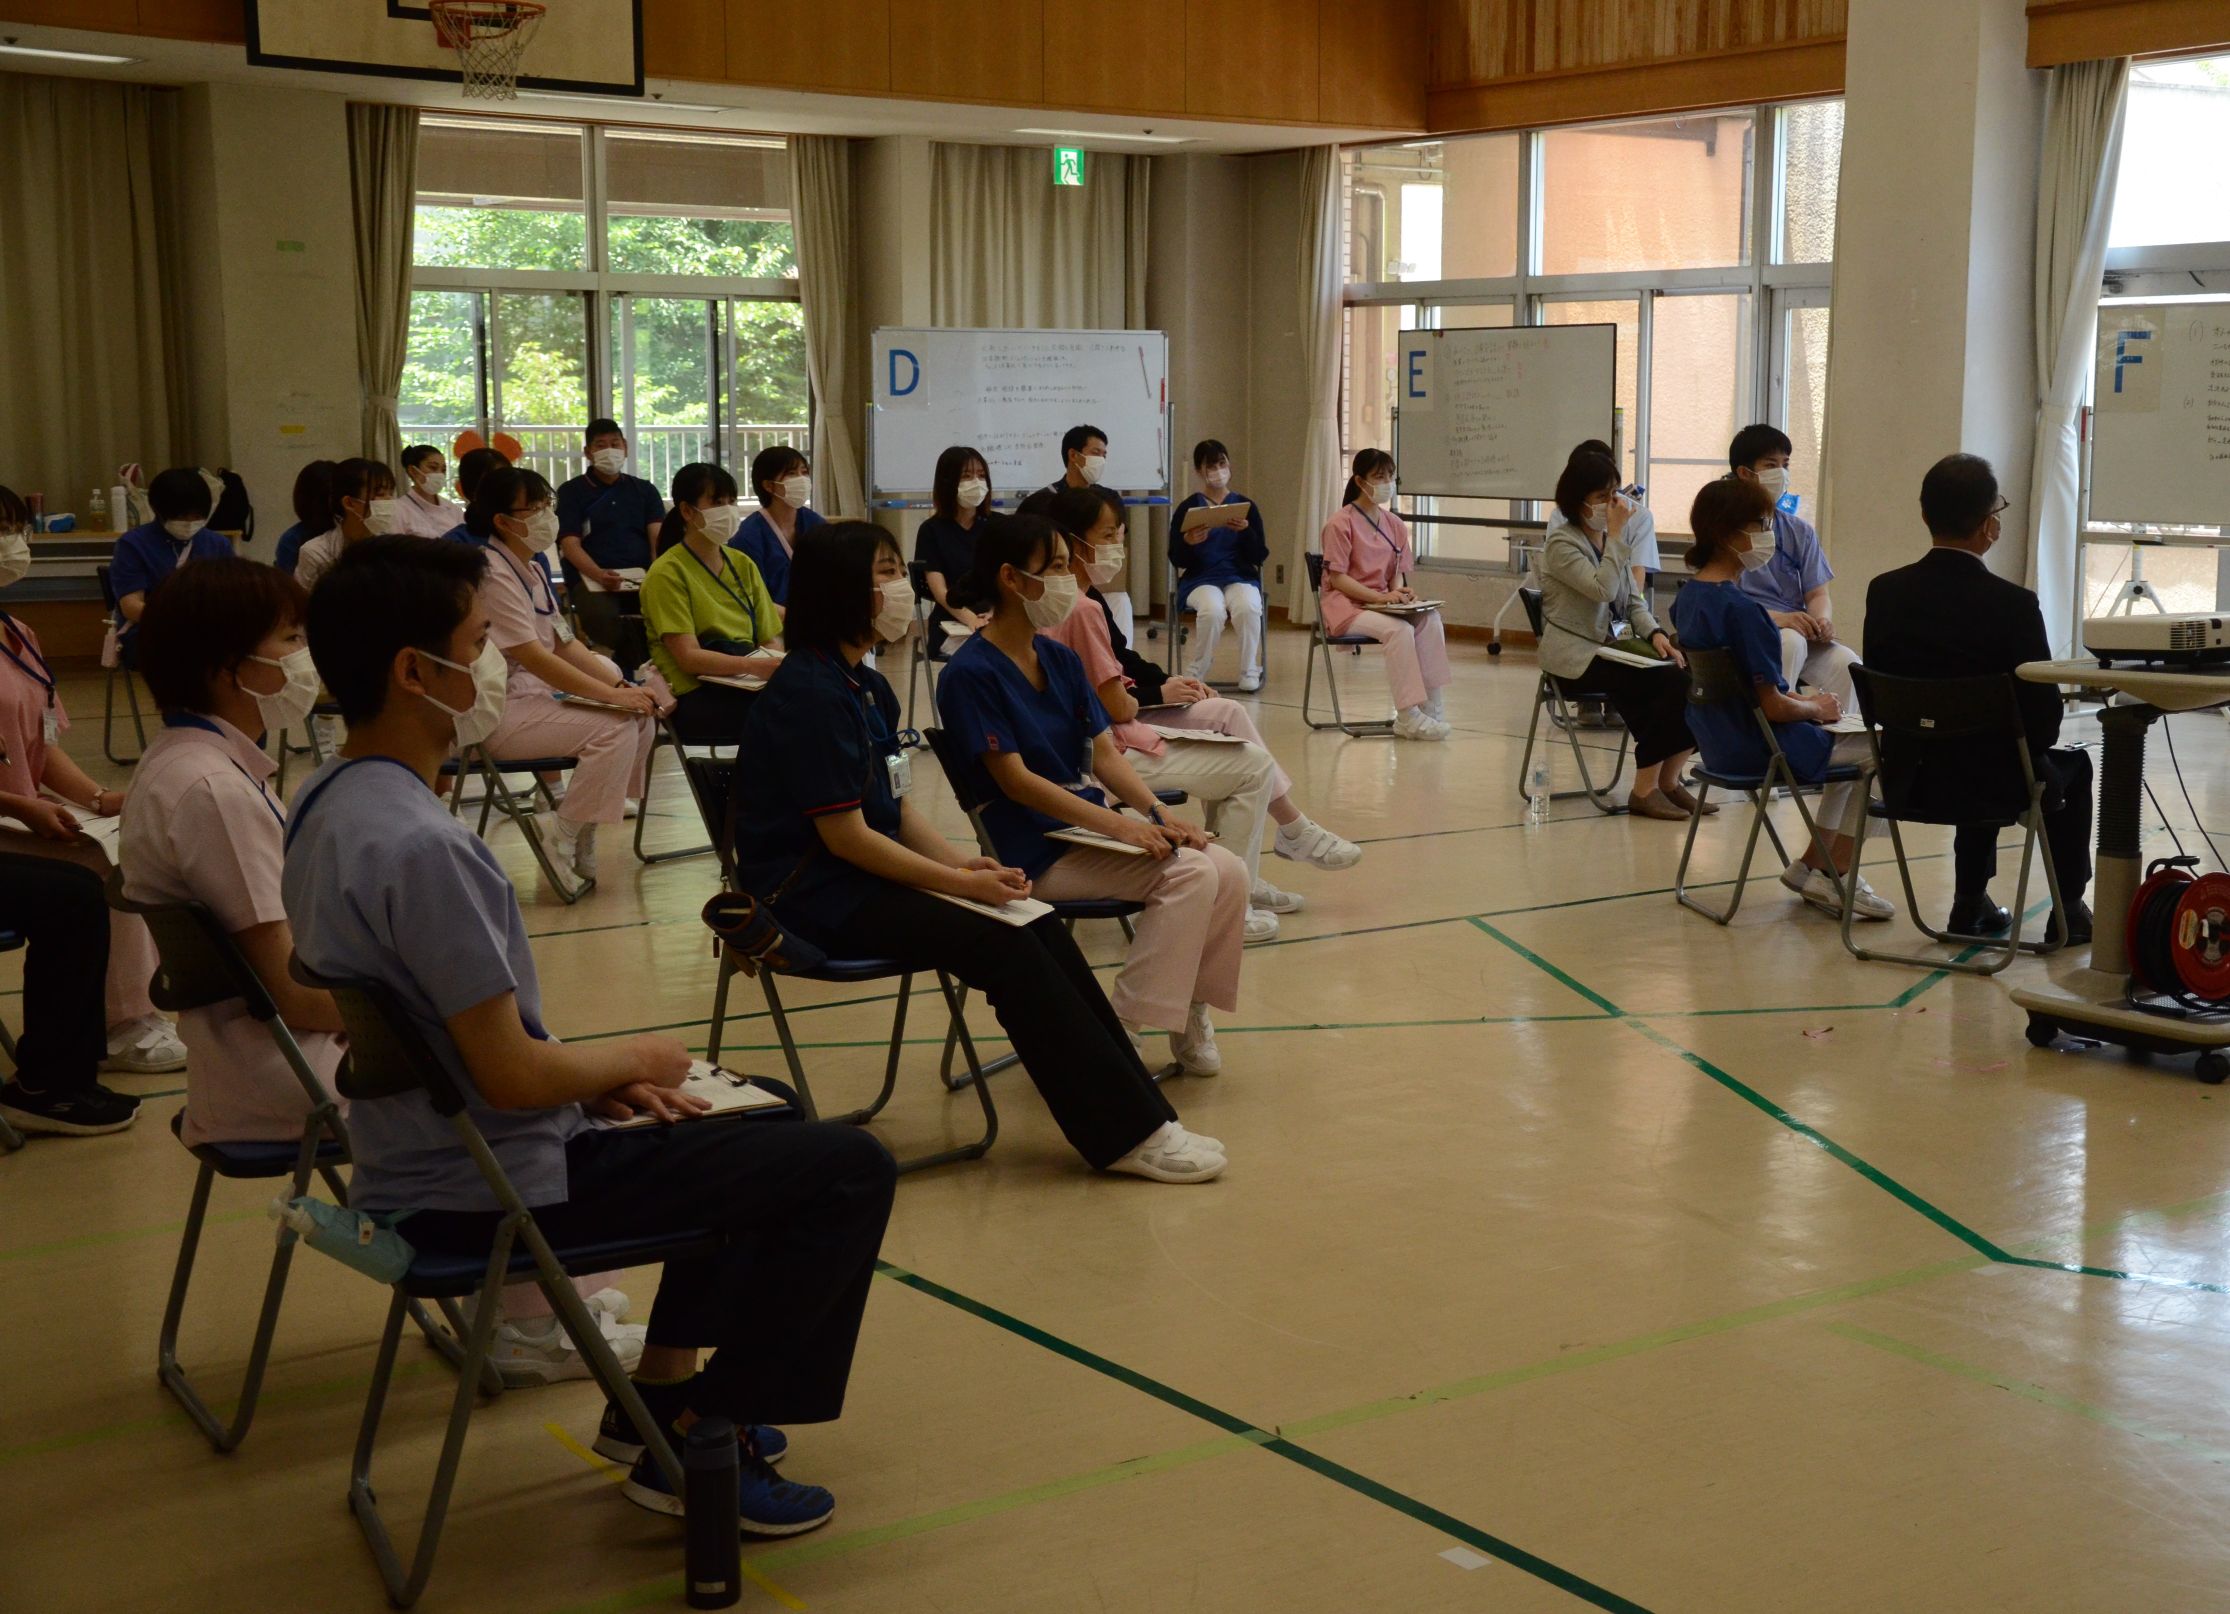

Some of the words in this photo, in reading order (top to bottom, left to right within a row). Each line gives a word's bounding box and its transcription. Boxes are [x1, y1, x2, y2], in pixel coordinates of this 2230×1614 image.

[889, 349, 920, 396] D
[1409, 350, 1427, 397] E
[2114, 331, 2152, 393] F
